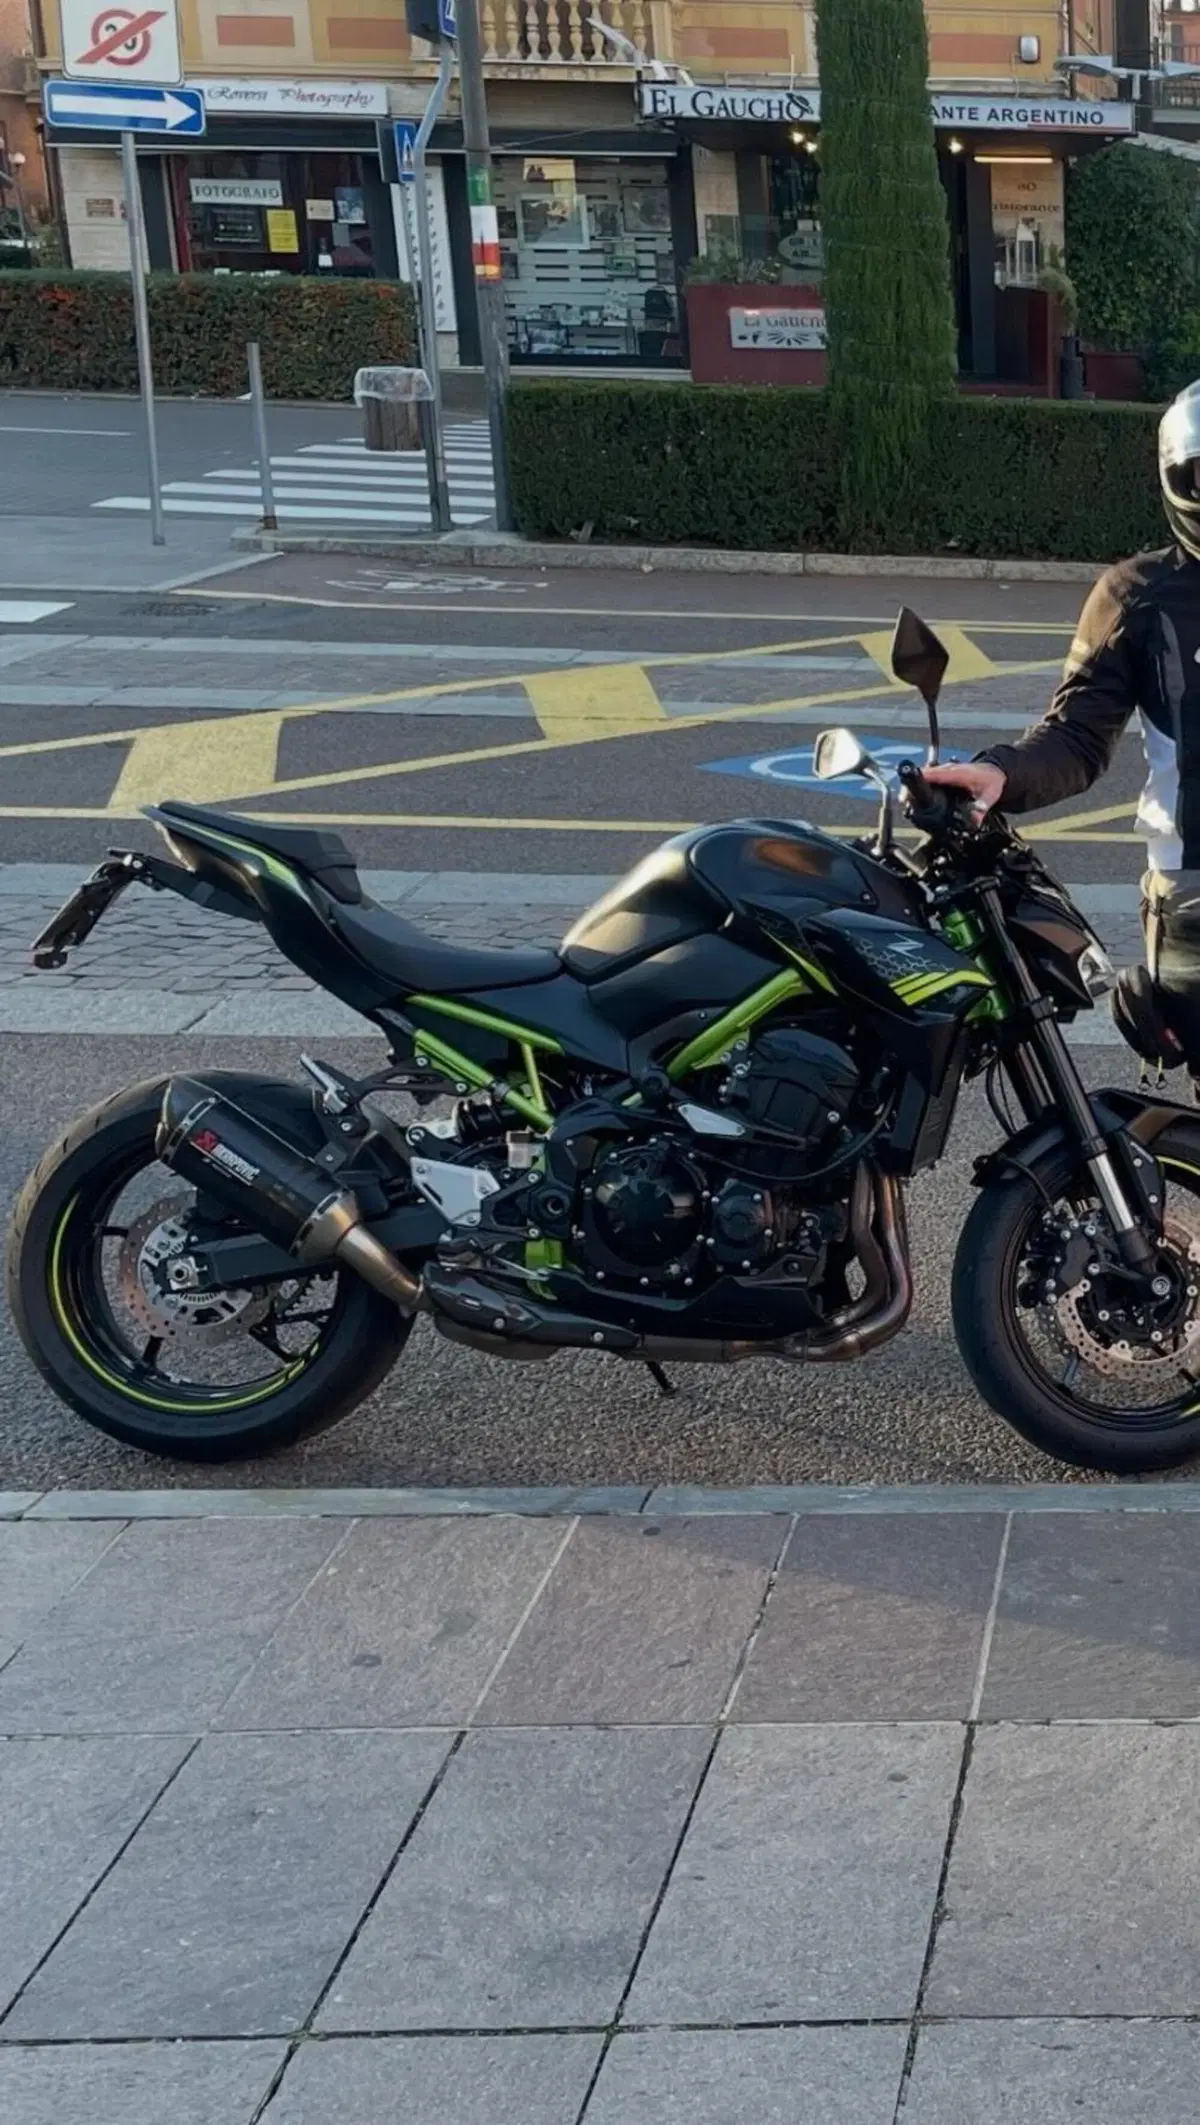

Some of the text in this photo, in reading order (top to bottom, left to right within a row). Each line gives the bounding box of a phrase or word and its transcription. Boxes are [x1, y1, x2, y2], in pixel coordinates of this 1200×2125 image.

[276, 88, 375, 109] Photography
[650, 88, 805, 120] EL GAUCHO
[986, 107, 1104, 125] ARGENTINO
[194, 184, 280, 199] FOTOGRAFO
